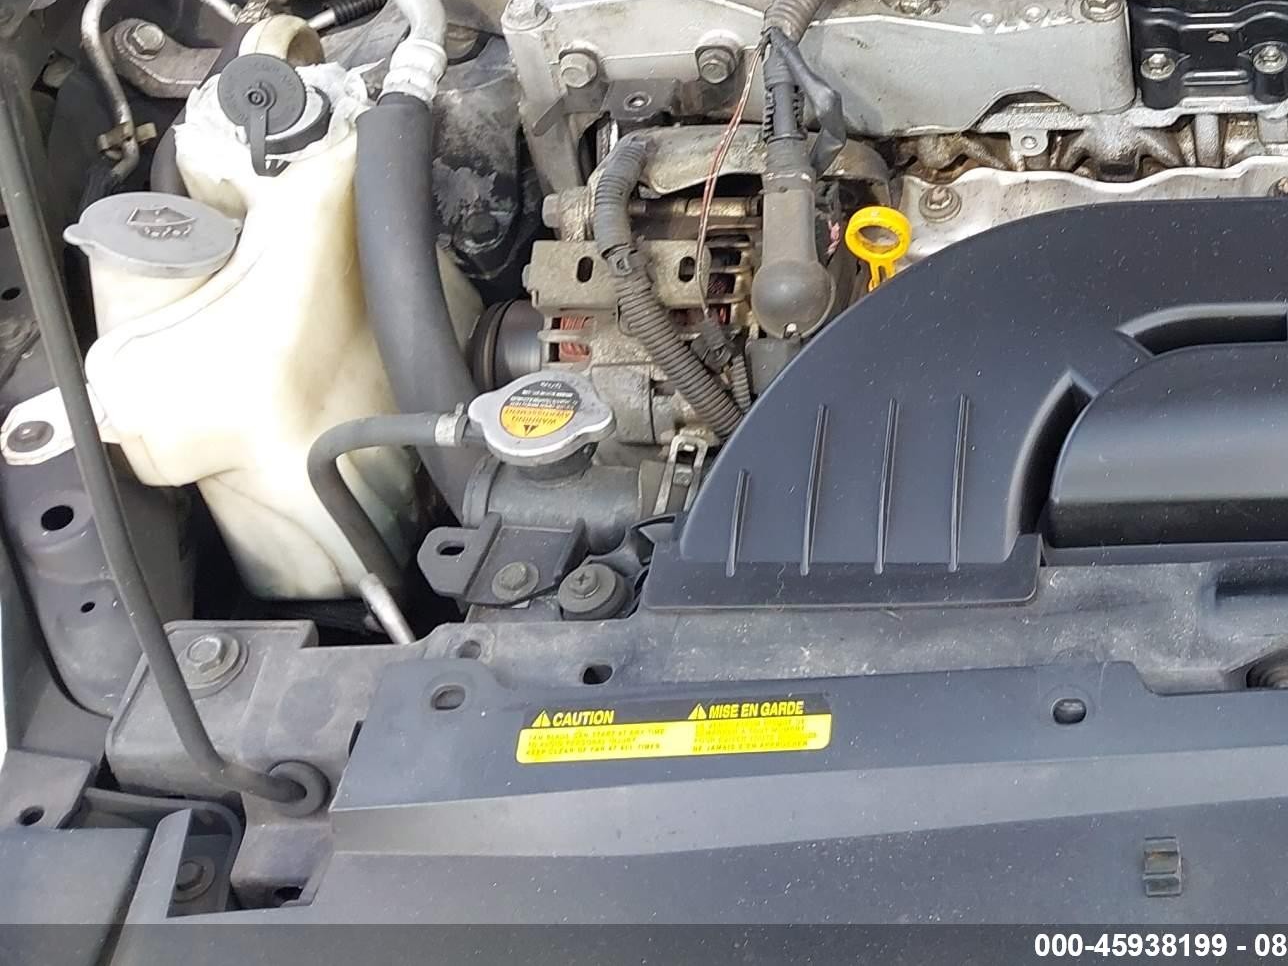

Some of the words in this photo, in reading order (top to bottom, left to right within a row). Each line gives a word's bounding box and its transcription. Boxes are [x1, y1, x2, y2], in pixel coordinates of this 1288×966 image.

[708, 703, 740, 718] MISE
[741, 703, 759, 716] EN
[762, 701, 804, 716] GARDE
[552, 710, 614, 726] CAUTION
